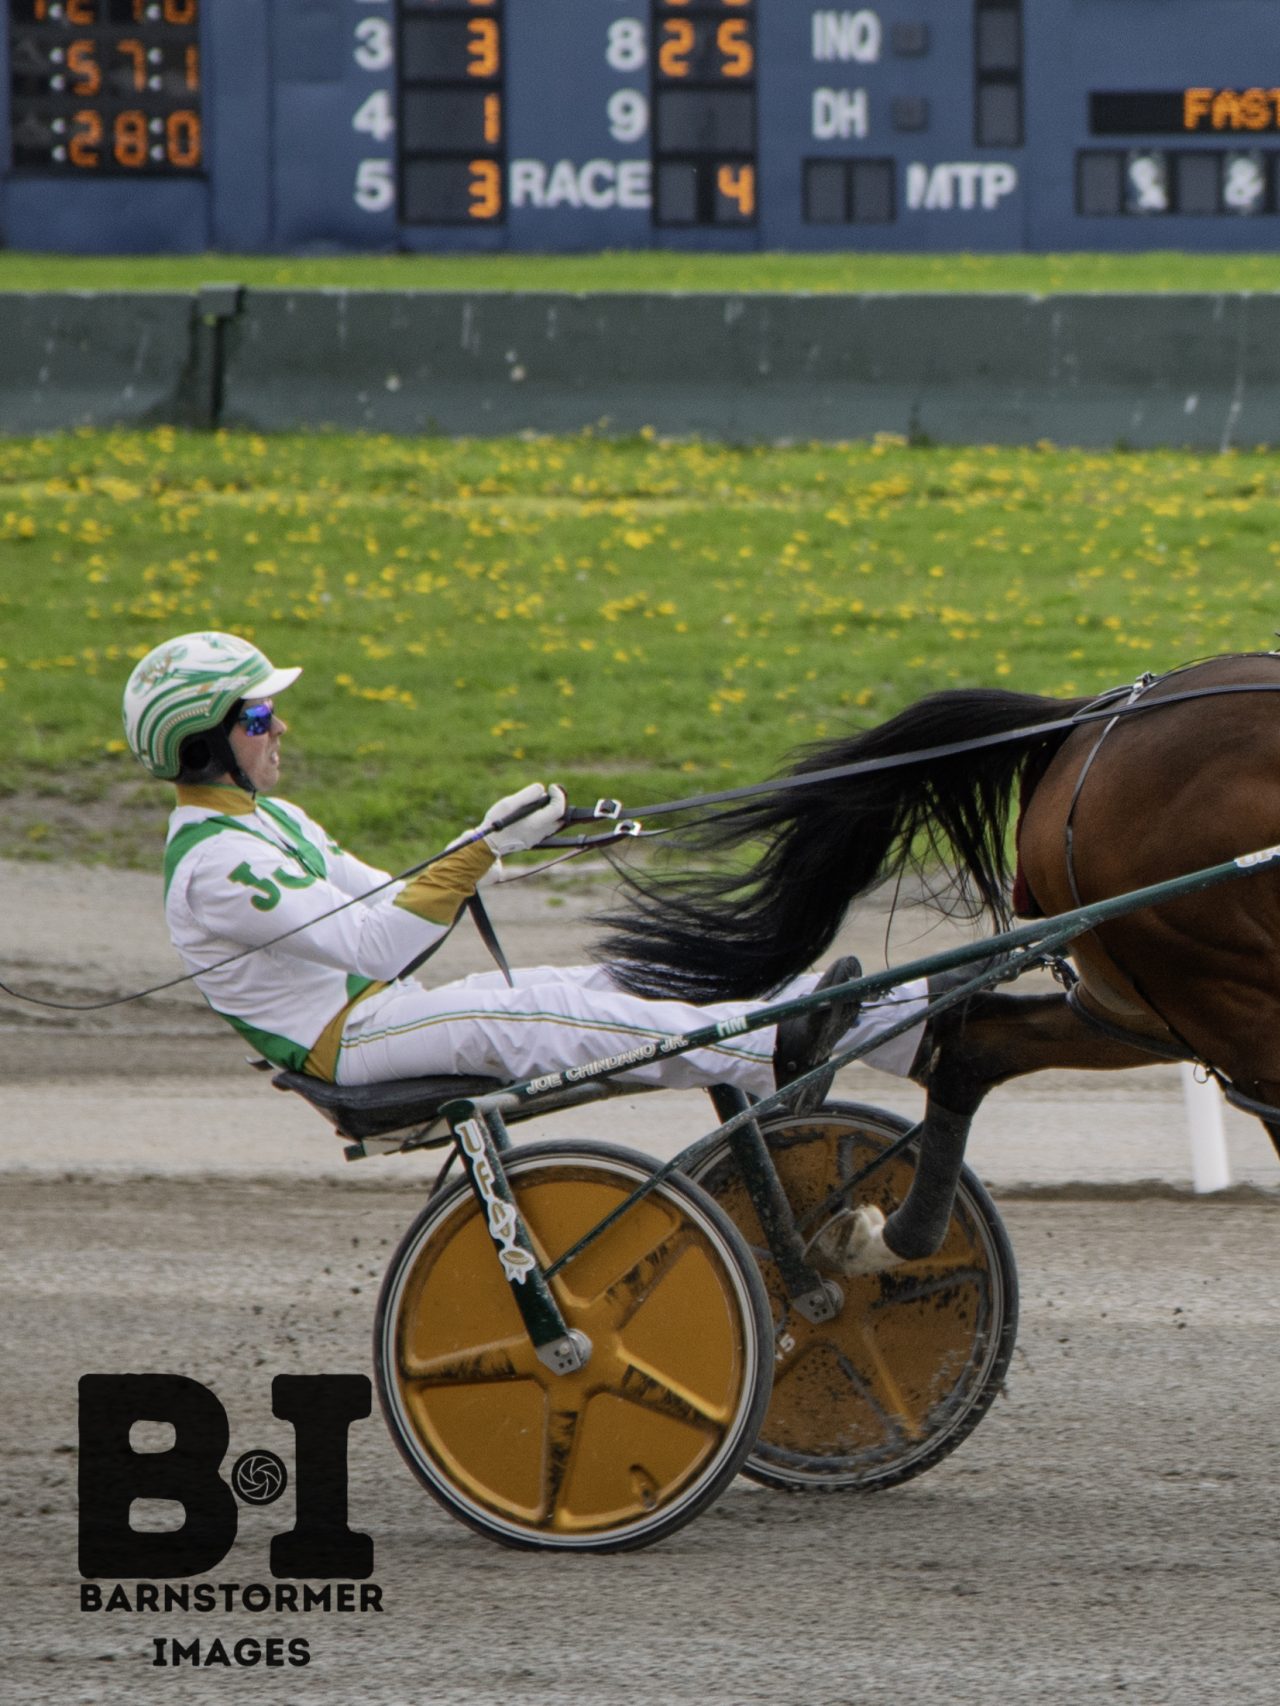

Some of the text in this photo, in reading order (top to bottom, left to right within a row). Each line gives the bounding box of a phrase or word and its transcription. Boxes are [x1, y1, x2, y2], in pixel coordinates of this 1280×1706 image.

[354, 18, 393, 70] 3
[467, 18, 499, 77] 3
[606, 18, 647, 71] 8
[812, 10, 881, 63] INQ
[353, 90, 393, 141] 4
[484, 94, 500, 143] 1
[607, 89, 649, 142] 9
[812, 89, 868, 139] DH
[355, 160, 394, 212] 5
[468, 159, 500, 219] 3
[510, 160, 651, 208] RACE
[718, 166, 754, 215] 4
[906, 163, 1017, 209] MTP
[526, 1072, 563, 1095] JOE
